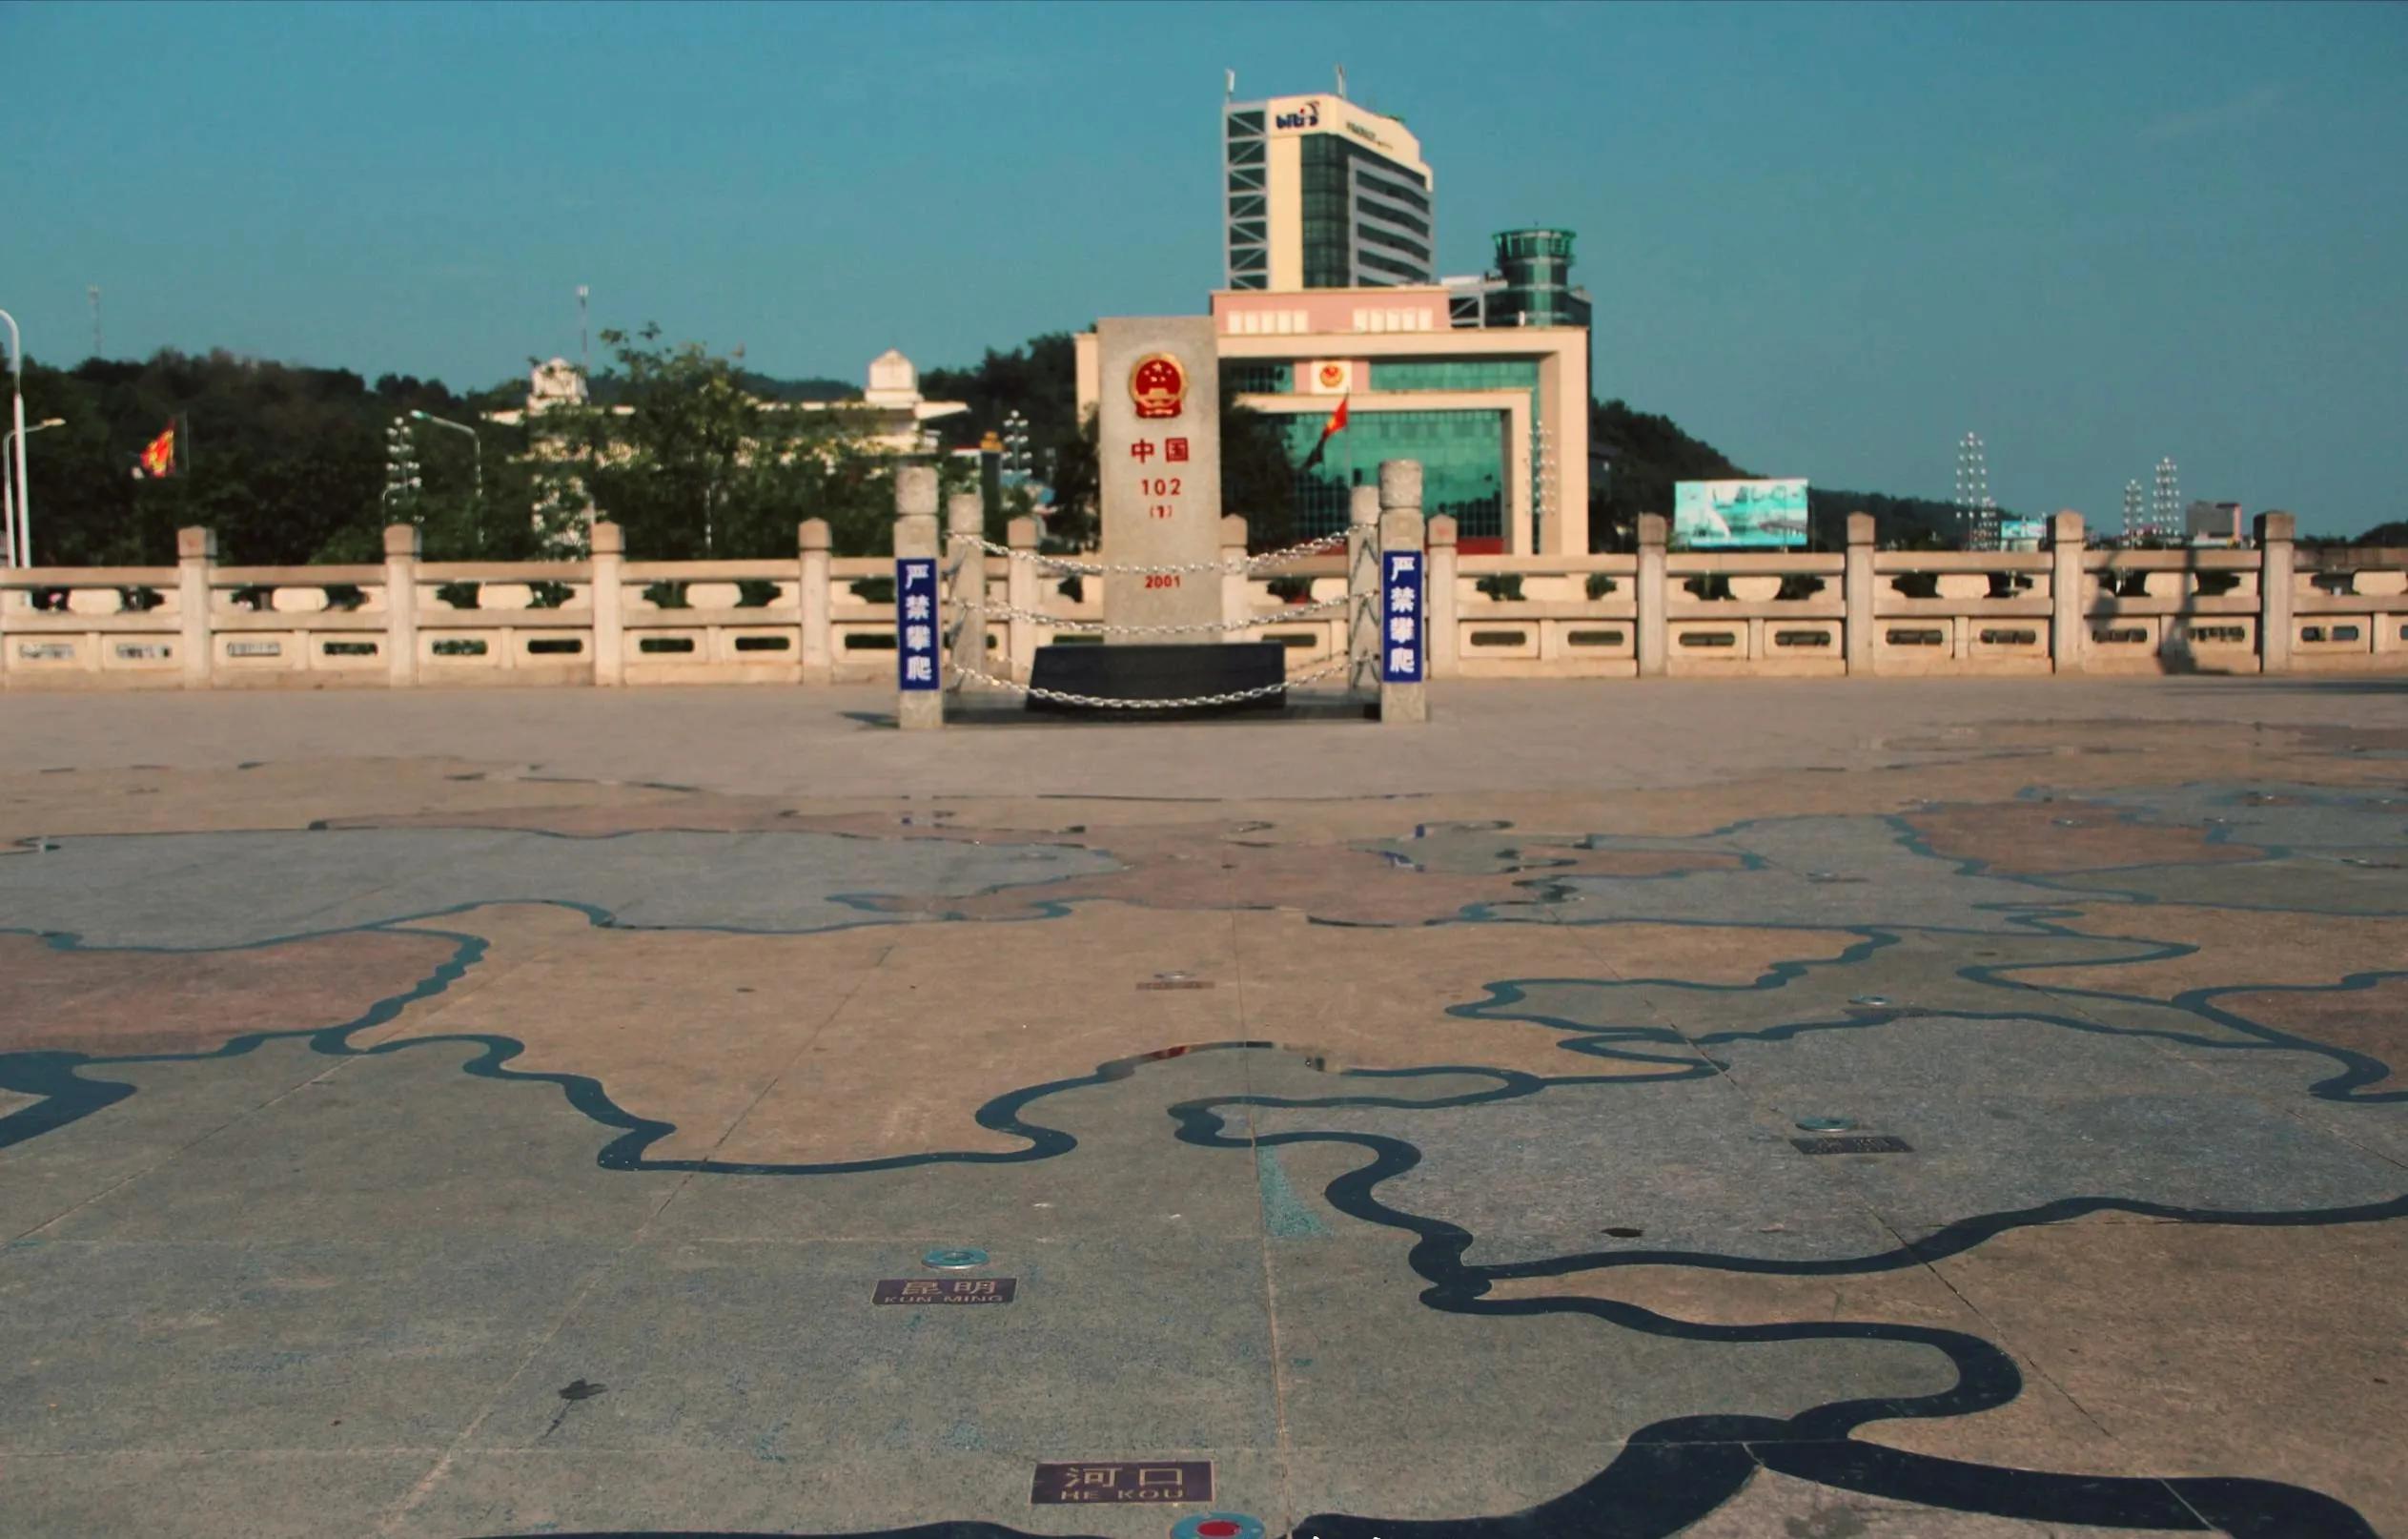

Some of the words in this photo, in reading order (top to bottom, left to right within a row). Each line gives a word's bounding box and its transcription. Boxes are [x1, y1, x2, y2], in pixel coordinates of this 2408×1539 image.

[1131, 438, 1189, 462] 中国
[1142, 478, 1181, 496] 102
[1145, 574, 1180, 588] 2001
[906, 564, 931, 681] 严禁攀爬
[1390, 556, 1415, 673] 严禁攀爬
[901, 1281, 995, 1295] 昆明
[1065, 1467, 1183, 1488] 河口
[1061, 1490, 1099, 1500] HE
[1117, 1489, 1183, 1499] KOU
